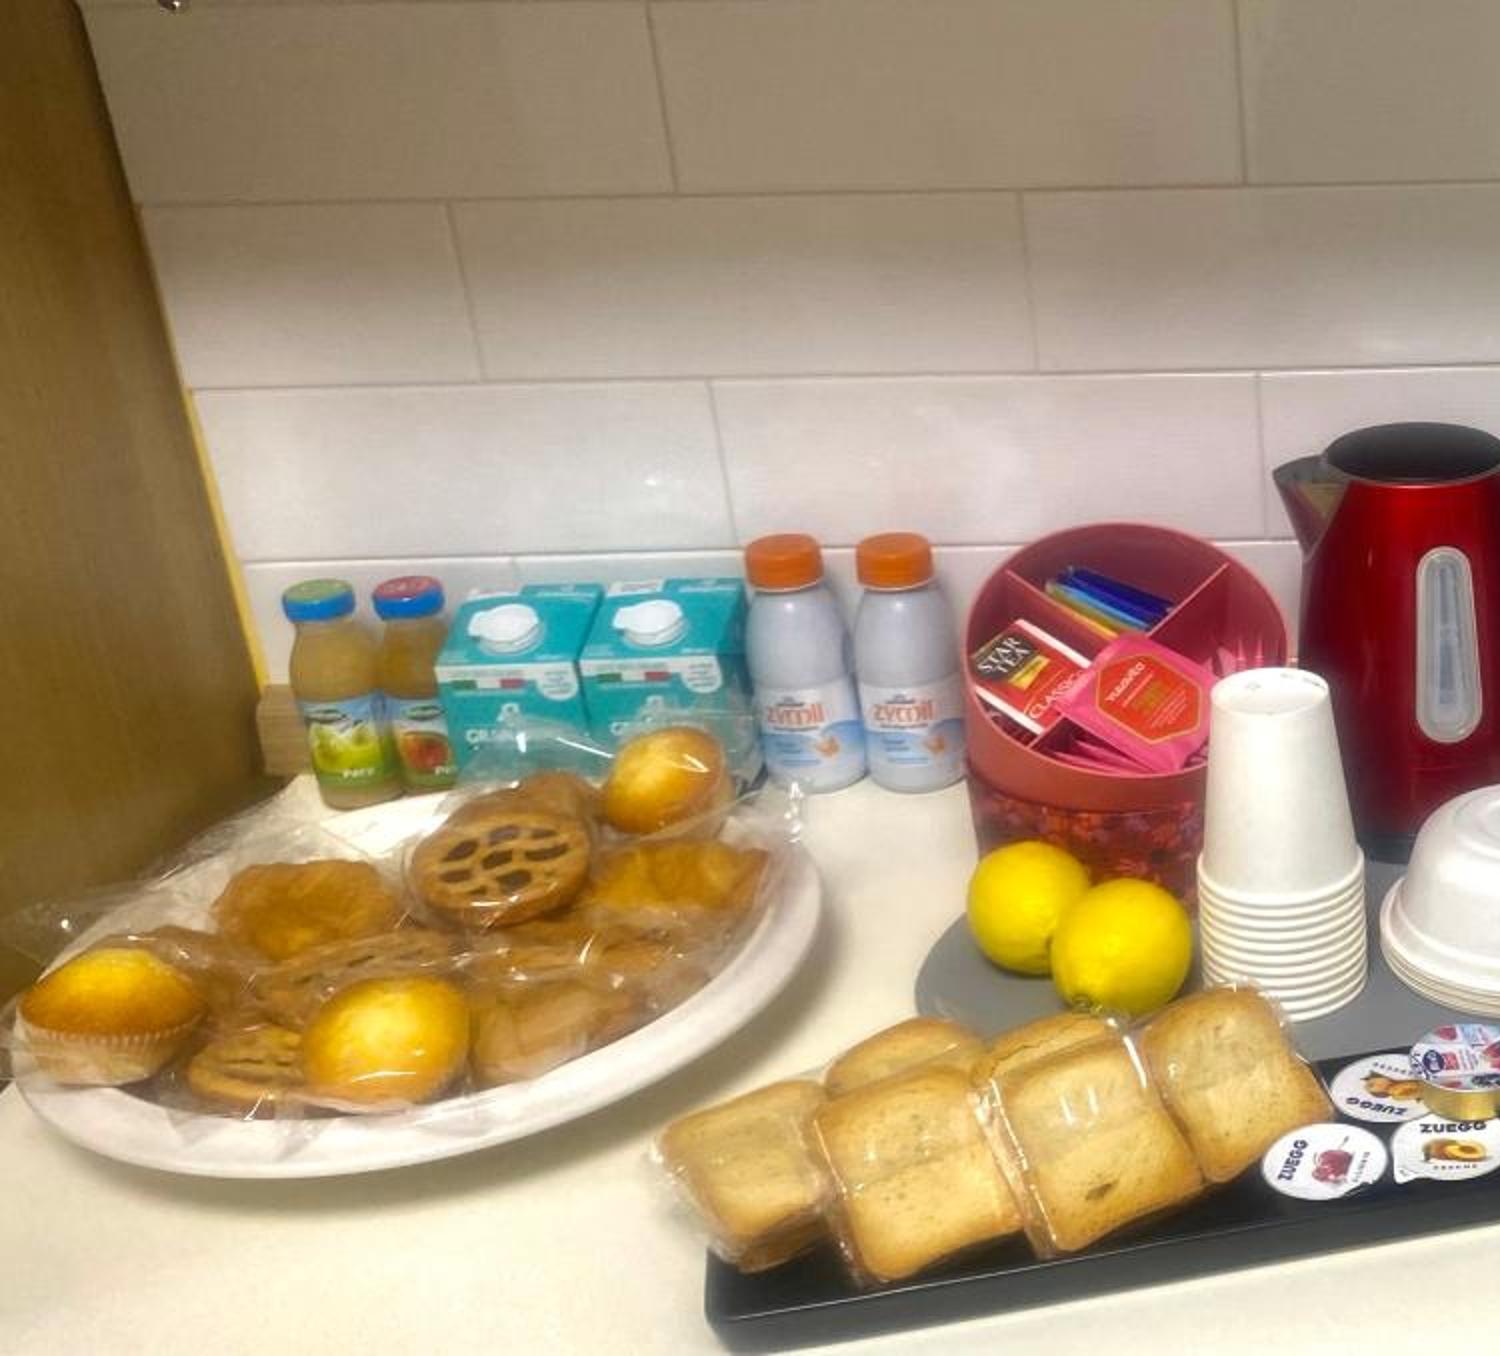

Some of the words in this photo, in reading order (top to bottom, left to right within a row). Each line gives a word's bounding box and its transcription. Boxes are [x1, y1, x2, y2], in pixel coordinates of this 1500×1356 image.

[976, 636, 1022, 673] STAR
[1346, 1096, 1408, 1116] ZUEGG
[1419, 1120, 1488, 1135] ZUEGG
[1277, 1138, 1309, 1181] ZUEGG
